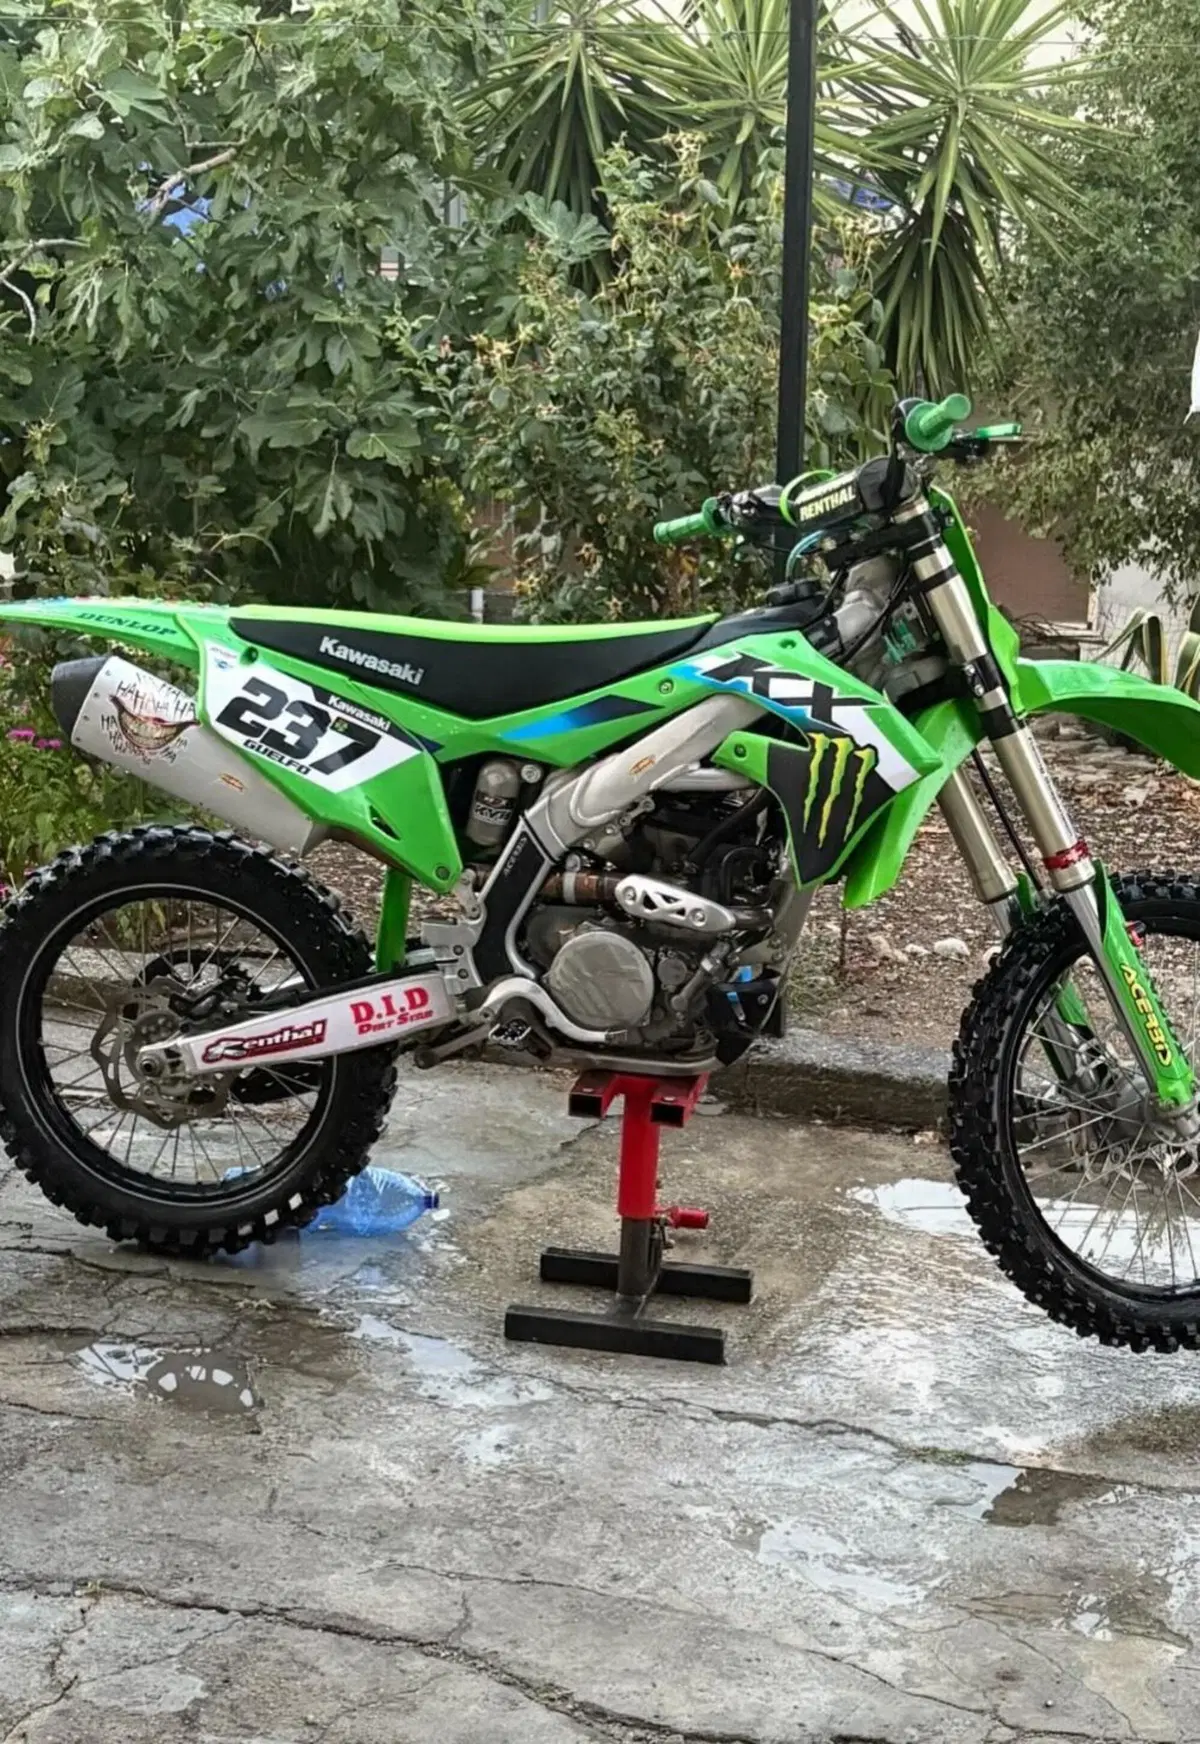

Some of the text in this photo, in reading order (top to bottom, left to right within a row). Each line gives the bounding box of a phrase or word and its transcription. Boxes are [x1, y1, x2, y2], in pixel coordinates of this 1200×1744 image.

[799, 485, 857, 522] RENTHAL
[75, 612, 178, 636] DUNLOP
[319, 635, 425, 686] Kawasaki
[215, 676, 382, 775] 237
[328, 694, 391, 732] Kawasaki
[243, 738, 312, 776] GUELFO
[350, 986, 430, 1025] D.I.D
